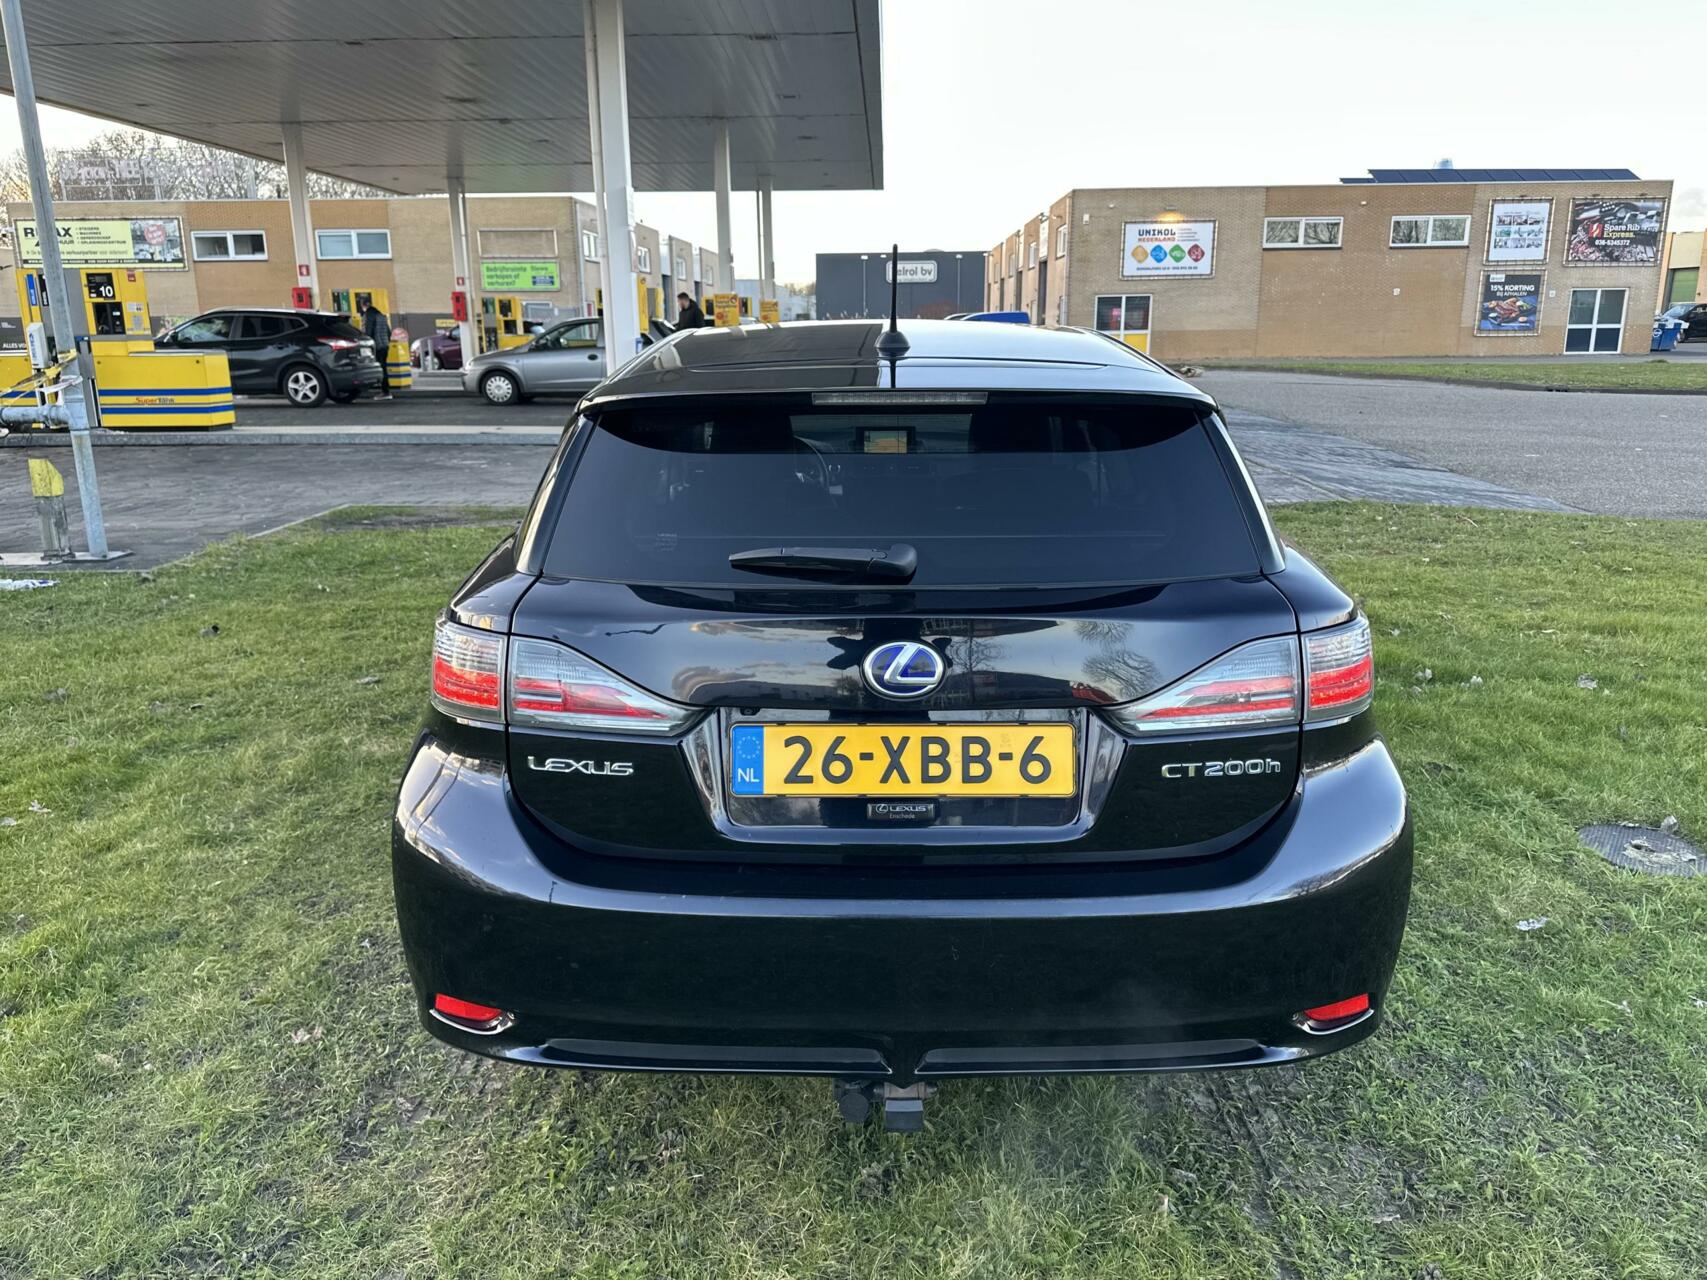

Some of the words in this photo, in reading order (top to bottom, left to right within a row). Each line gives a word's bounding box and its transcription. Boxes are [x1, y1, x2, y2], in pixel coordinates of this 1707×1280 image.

[1138, 228, 1176, 237] UNIKOL
[1604, 223, 1627, 232] Spare
[1627, 223, 1640, 231] Rib
[921, 266, 933, 276] bv
[99, 286, 113, 297] 10
[1490, 284, 1504, 292] 15%
[1504, 284, 1535, 292] KORTING
[783, 735, 1049, 785] 26-XBB-6
[527, 756, 634, 776] LEXUS
[737, 769, 760, 783] NL
